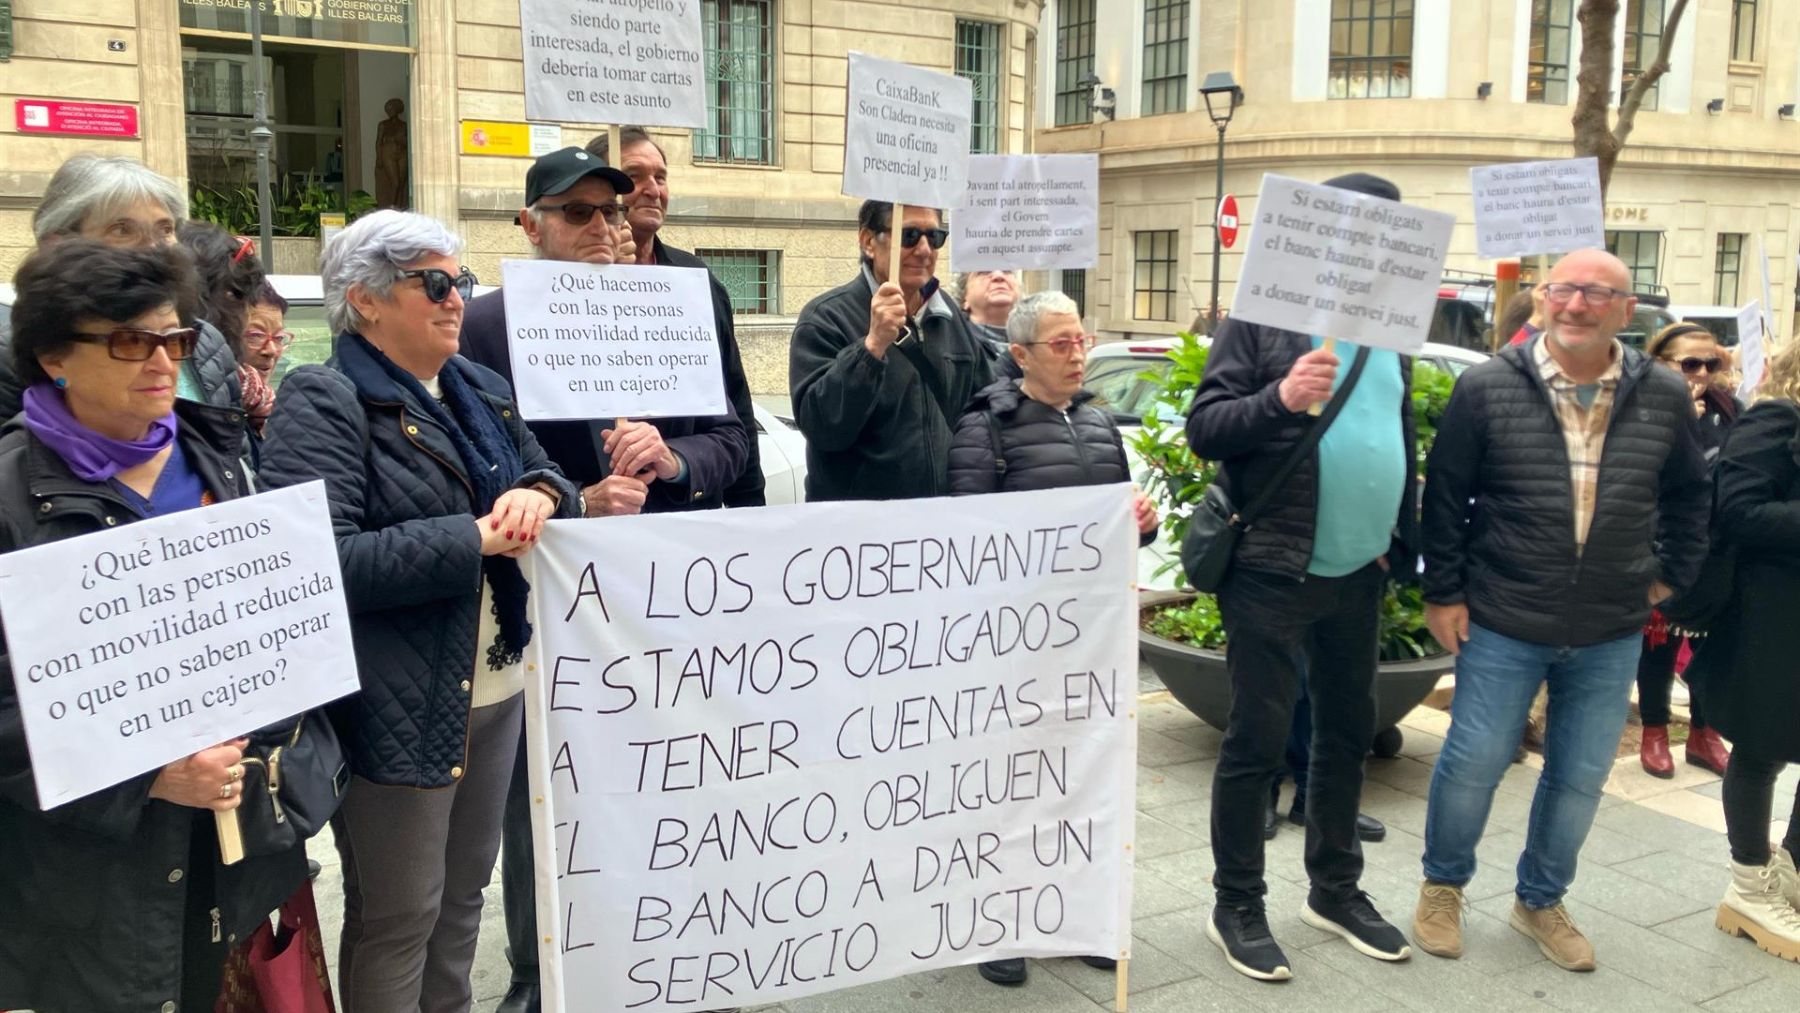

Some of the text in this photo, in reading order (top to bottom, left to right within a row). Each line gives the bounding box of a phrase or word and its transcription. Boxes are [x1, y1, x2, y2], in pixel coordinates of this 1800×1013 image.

[216, 0, 266, 11] BALEAS
[328, 0, 397, 13] GOBIERNO EN
[328, 9, 403, 23] ILLES BALEARS
[609, 0, 674, 13] atropello
[679, 1, 687, 17] y
[570, 10, 661, 35] siendo parte
[530, 30, 700, 63] interesada, el gobierno
[541, 58, 692, 87] debería tomar cartas
[567, 89, 672, 109] en este asunto
[875, 78, 942, 108] CaixaBanK
[859, 100, 956, 134] Son Cladera necesita
[876, 132, 938, 155] una oficina
[863, 156, 920, 177] presencial
[923, 168, 937, 182] ya
[1002, 180, 1015, 191] tal
[976, 197, 997, 206] sent
[1000, 196, 1021, 208] part
[1024, 195, 1079, 207] interessada,
[1312, 197, 1361, 218] estam
[1365, 207, 1424, 232] obligats
[1001, 211, 1010, 222] el
[965, 228, 998, 239] hauria
[1000, 227, 1012, 238] de
[1015, 227, 1051, 240] prendre
[1263, 212, 1438, 262] a tenir compte bancari,
[977, 245, 990, 255] en
[992, 243, 1025, 255] aquest
[1264, 235, 1429, 281] el banc hauria d'estar
[551, 272, 671, 293] ¿Qué hacemos
[1315, 271, 1372, 295] obligat
[549, 299, 684, 321] con las personas
[1251, 283, 1420, 329] a donar un servei just.
[517, 324, 712, 342] con movilidad reducida
[528, 350, 709, 370] o que no saben operar
[568, 374, 678, 396] en un cajero?
[80, 517, 272, 590] ¿Qué hacemos
[565, 522, 1102, 623] A LOS GOBERNANTES
[78, 550, 292, 625] con las personas
[27, 572, 334, 683] con movilidad reducida
[49, 611, 332, 720] o que no saben operar
[550, 598, 1081, 714] ESTAMOS OBLIGADOS
[119, 658, 288, 738] en un cajero?
[550, 668, 1117, 794] A TENER CUENTAS EN
[649, 791, 849, 871] BANCO,
[863, 746, 1067, 832] OBLIGUEN
[561, 817, 1093, 955] L BANCO A DAR UN
[625, 883, 1064, 1008] SERVICIO JUSTO
